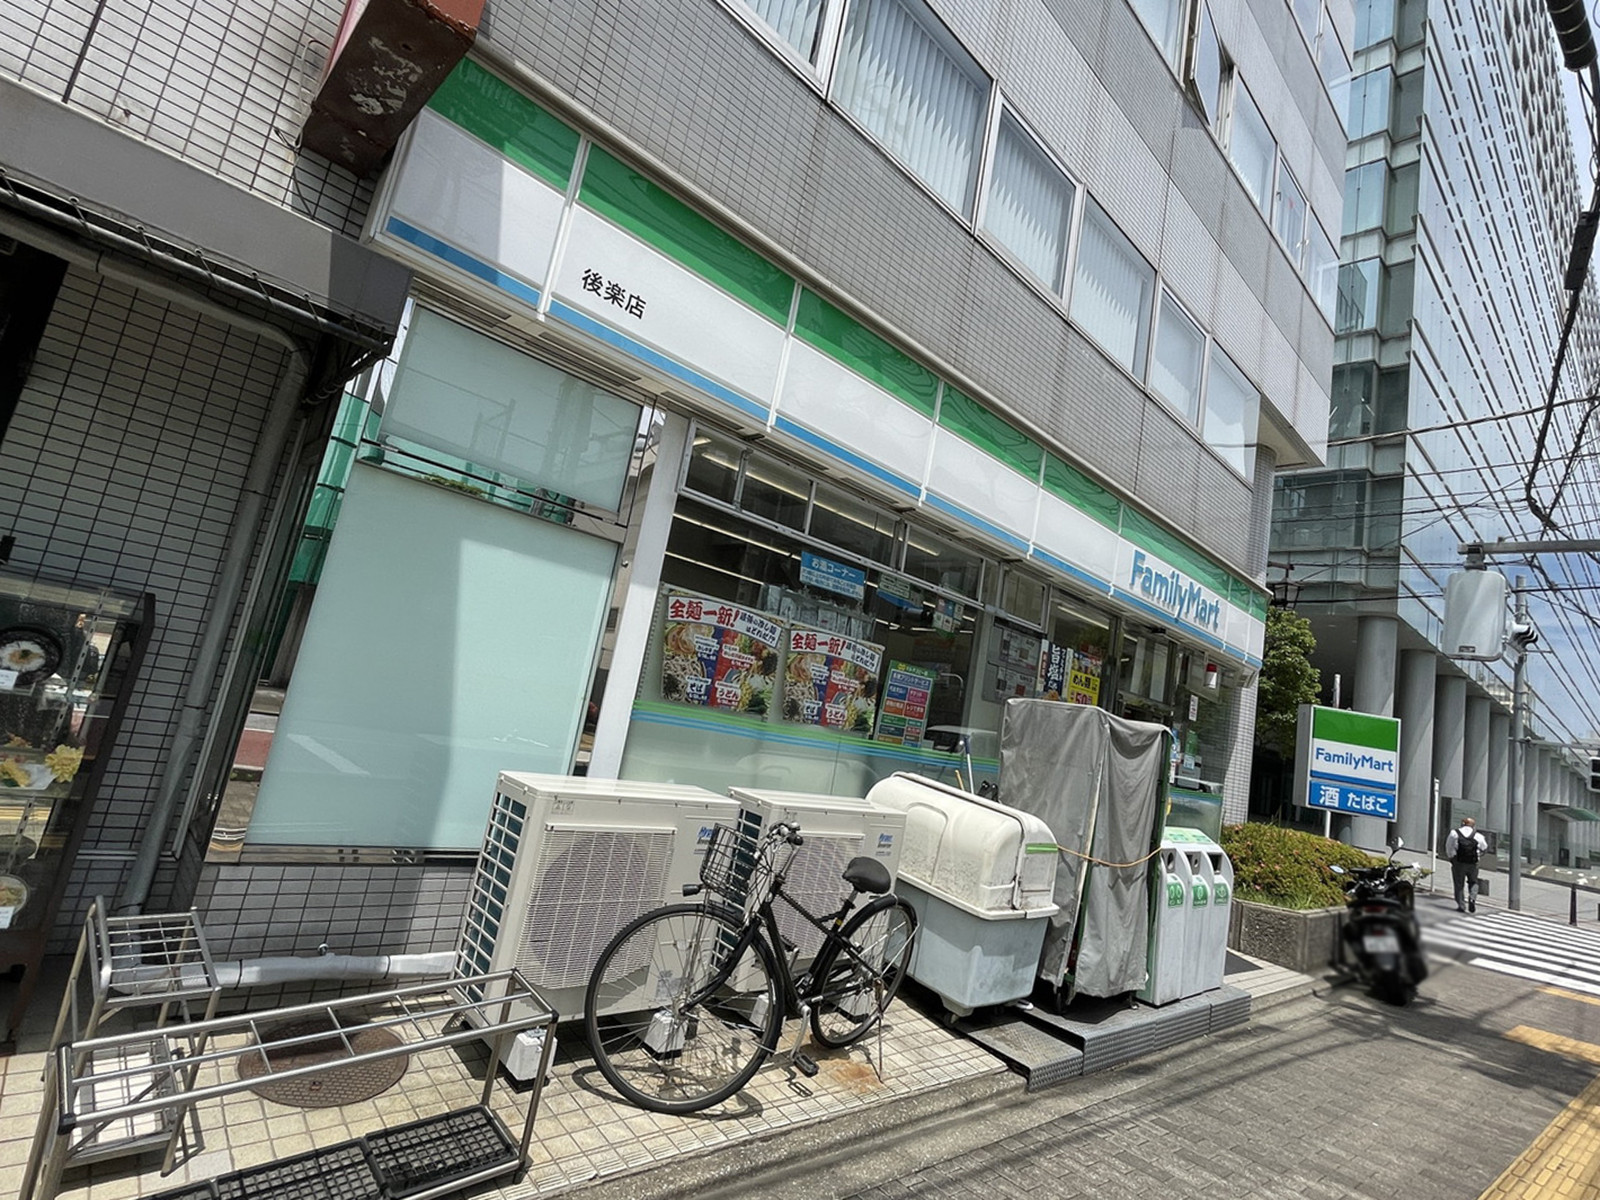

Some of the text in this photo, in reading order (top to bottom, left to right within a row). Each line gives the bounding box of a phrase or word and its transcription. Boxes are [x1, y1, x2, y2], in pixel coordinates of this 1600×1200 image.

[582, 268, 646, 320] 後楽店
[1130, 550, 1220, 632] FamilyMart
[1316, 747, 1393, 773] FamilyMart
[1319, 786, 1388, 813] 酒 たばこ
